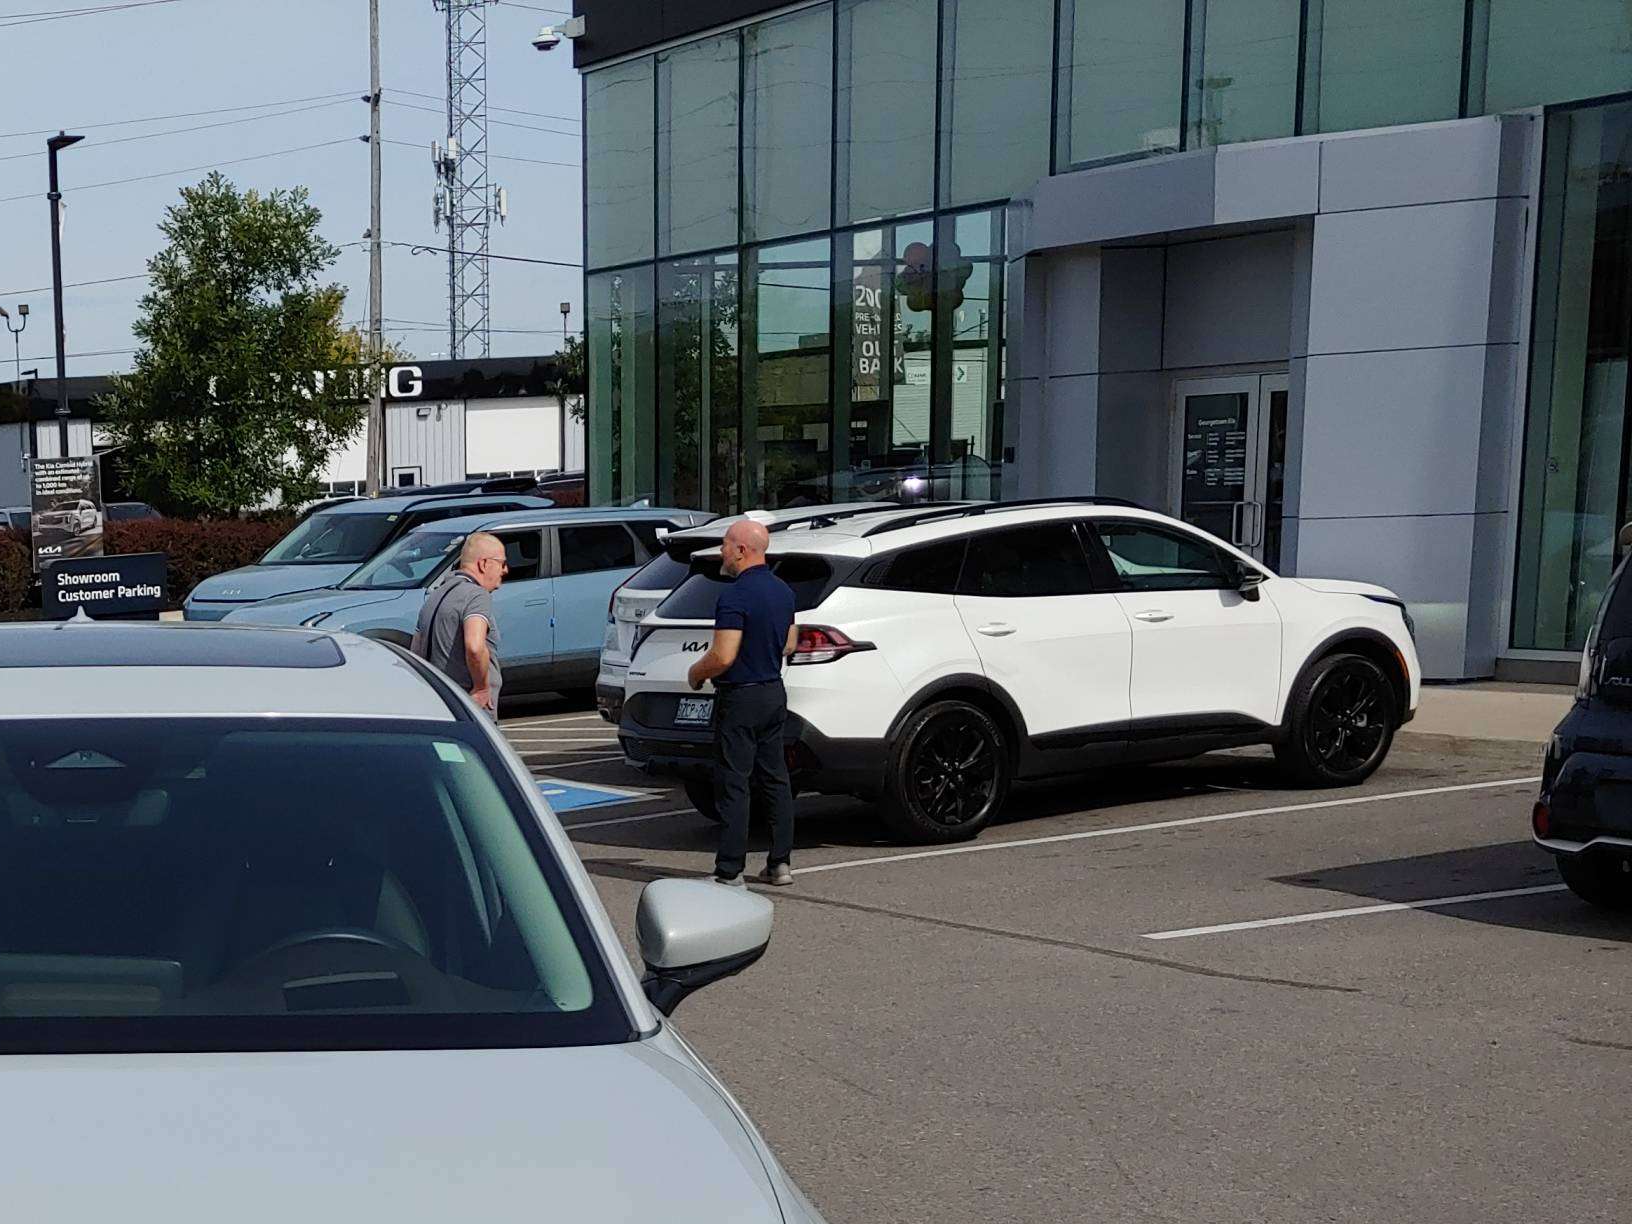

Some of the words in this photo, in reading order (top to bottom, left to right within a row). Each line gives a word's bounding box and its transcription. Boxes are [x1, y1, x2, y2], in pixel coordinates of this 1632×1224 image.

[859, 357, 904, 375] BAK
[38, 545, 62, 555] KIA
[56, 571, 121, 586] Showroom
[57, 588, 116, 603] Customer
[117, 583, 161, 598] Parking
[681, 641, 710, 653] KIA
